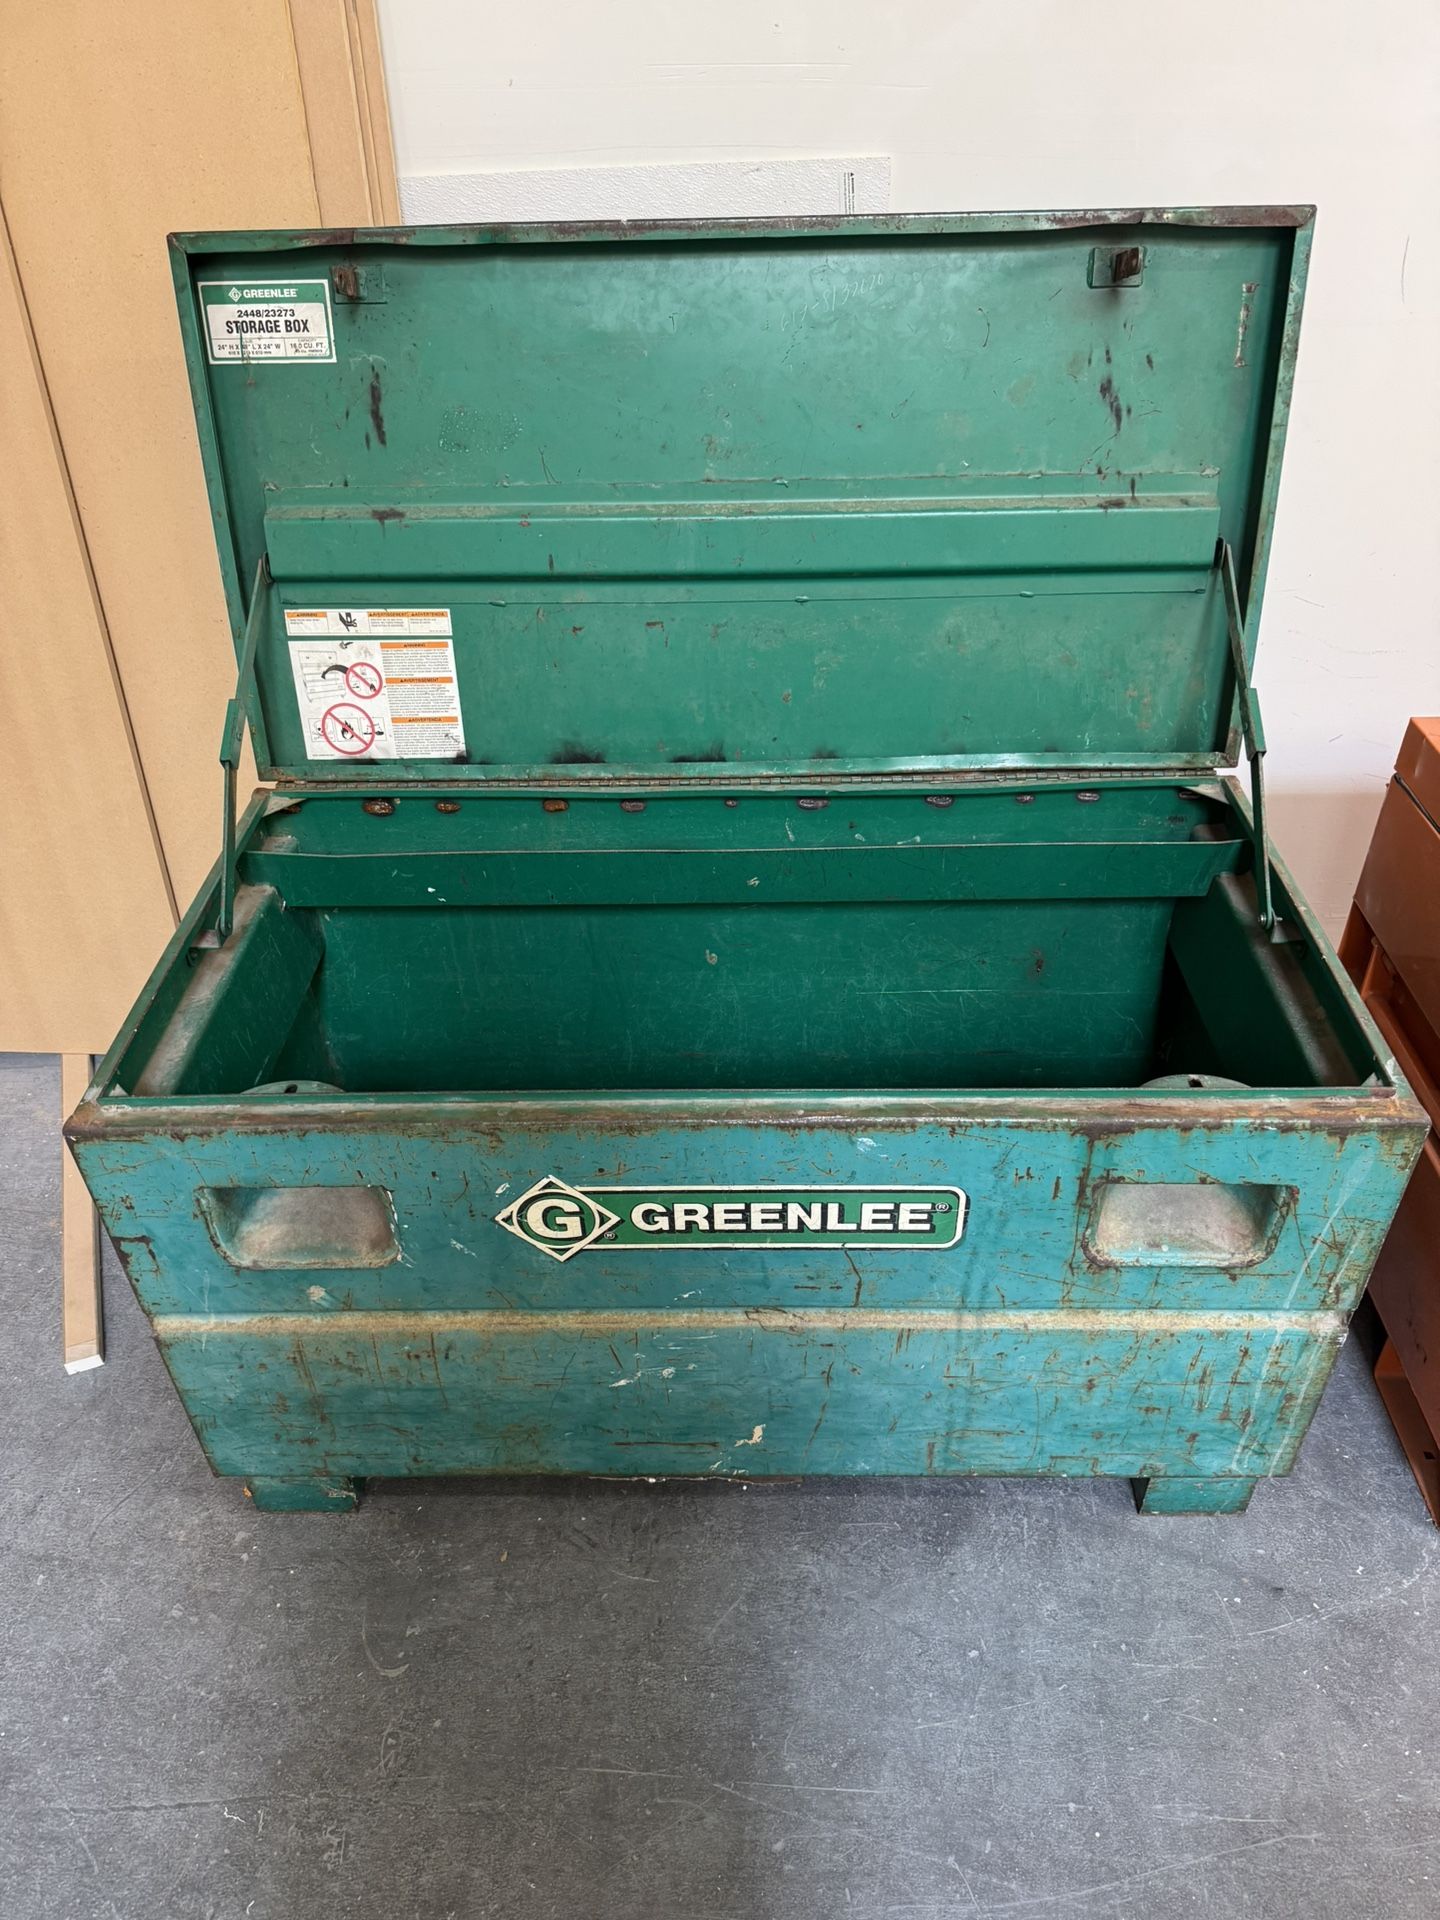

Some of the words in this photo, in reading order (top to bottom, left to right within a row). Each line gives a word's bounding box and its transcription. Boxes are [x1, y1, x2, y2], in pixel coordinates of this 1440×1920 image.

[243, 288, 298, 298] GREENLEE
[237, 309, 295, 318] 2448/23273
[226, 320, 281, 334] STORAGE
[285, 319, 310, 333] BOX
[526, 1198, 583, 1239] G
